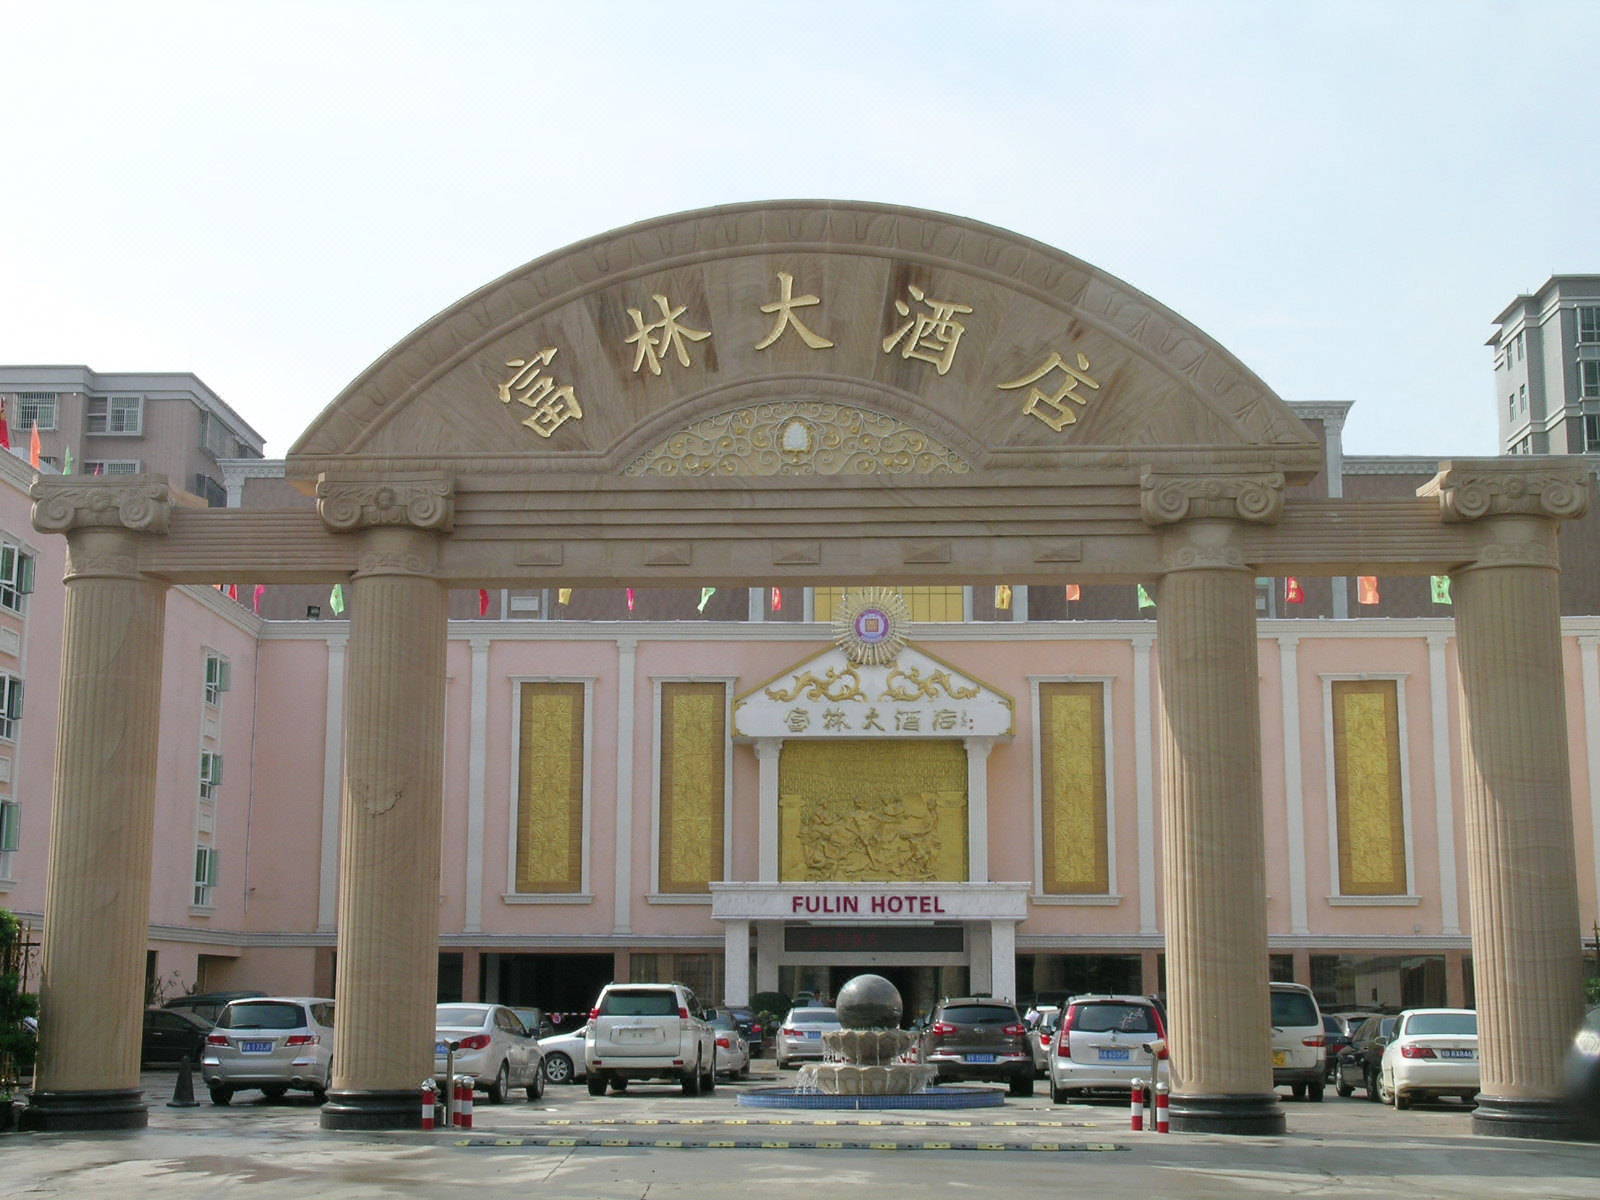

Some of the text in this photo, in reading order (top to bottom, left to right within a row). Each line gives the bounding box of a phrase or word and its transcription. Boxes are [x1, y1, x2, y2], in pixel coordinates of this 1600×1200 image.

[497, 271, 1101, 439] 富林大酒店
[783, 706, 958, 733] 富林大酒店
[792, 895, 946, 914] FULIN HOTEL
